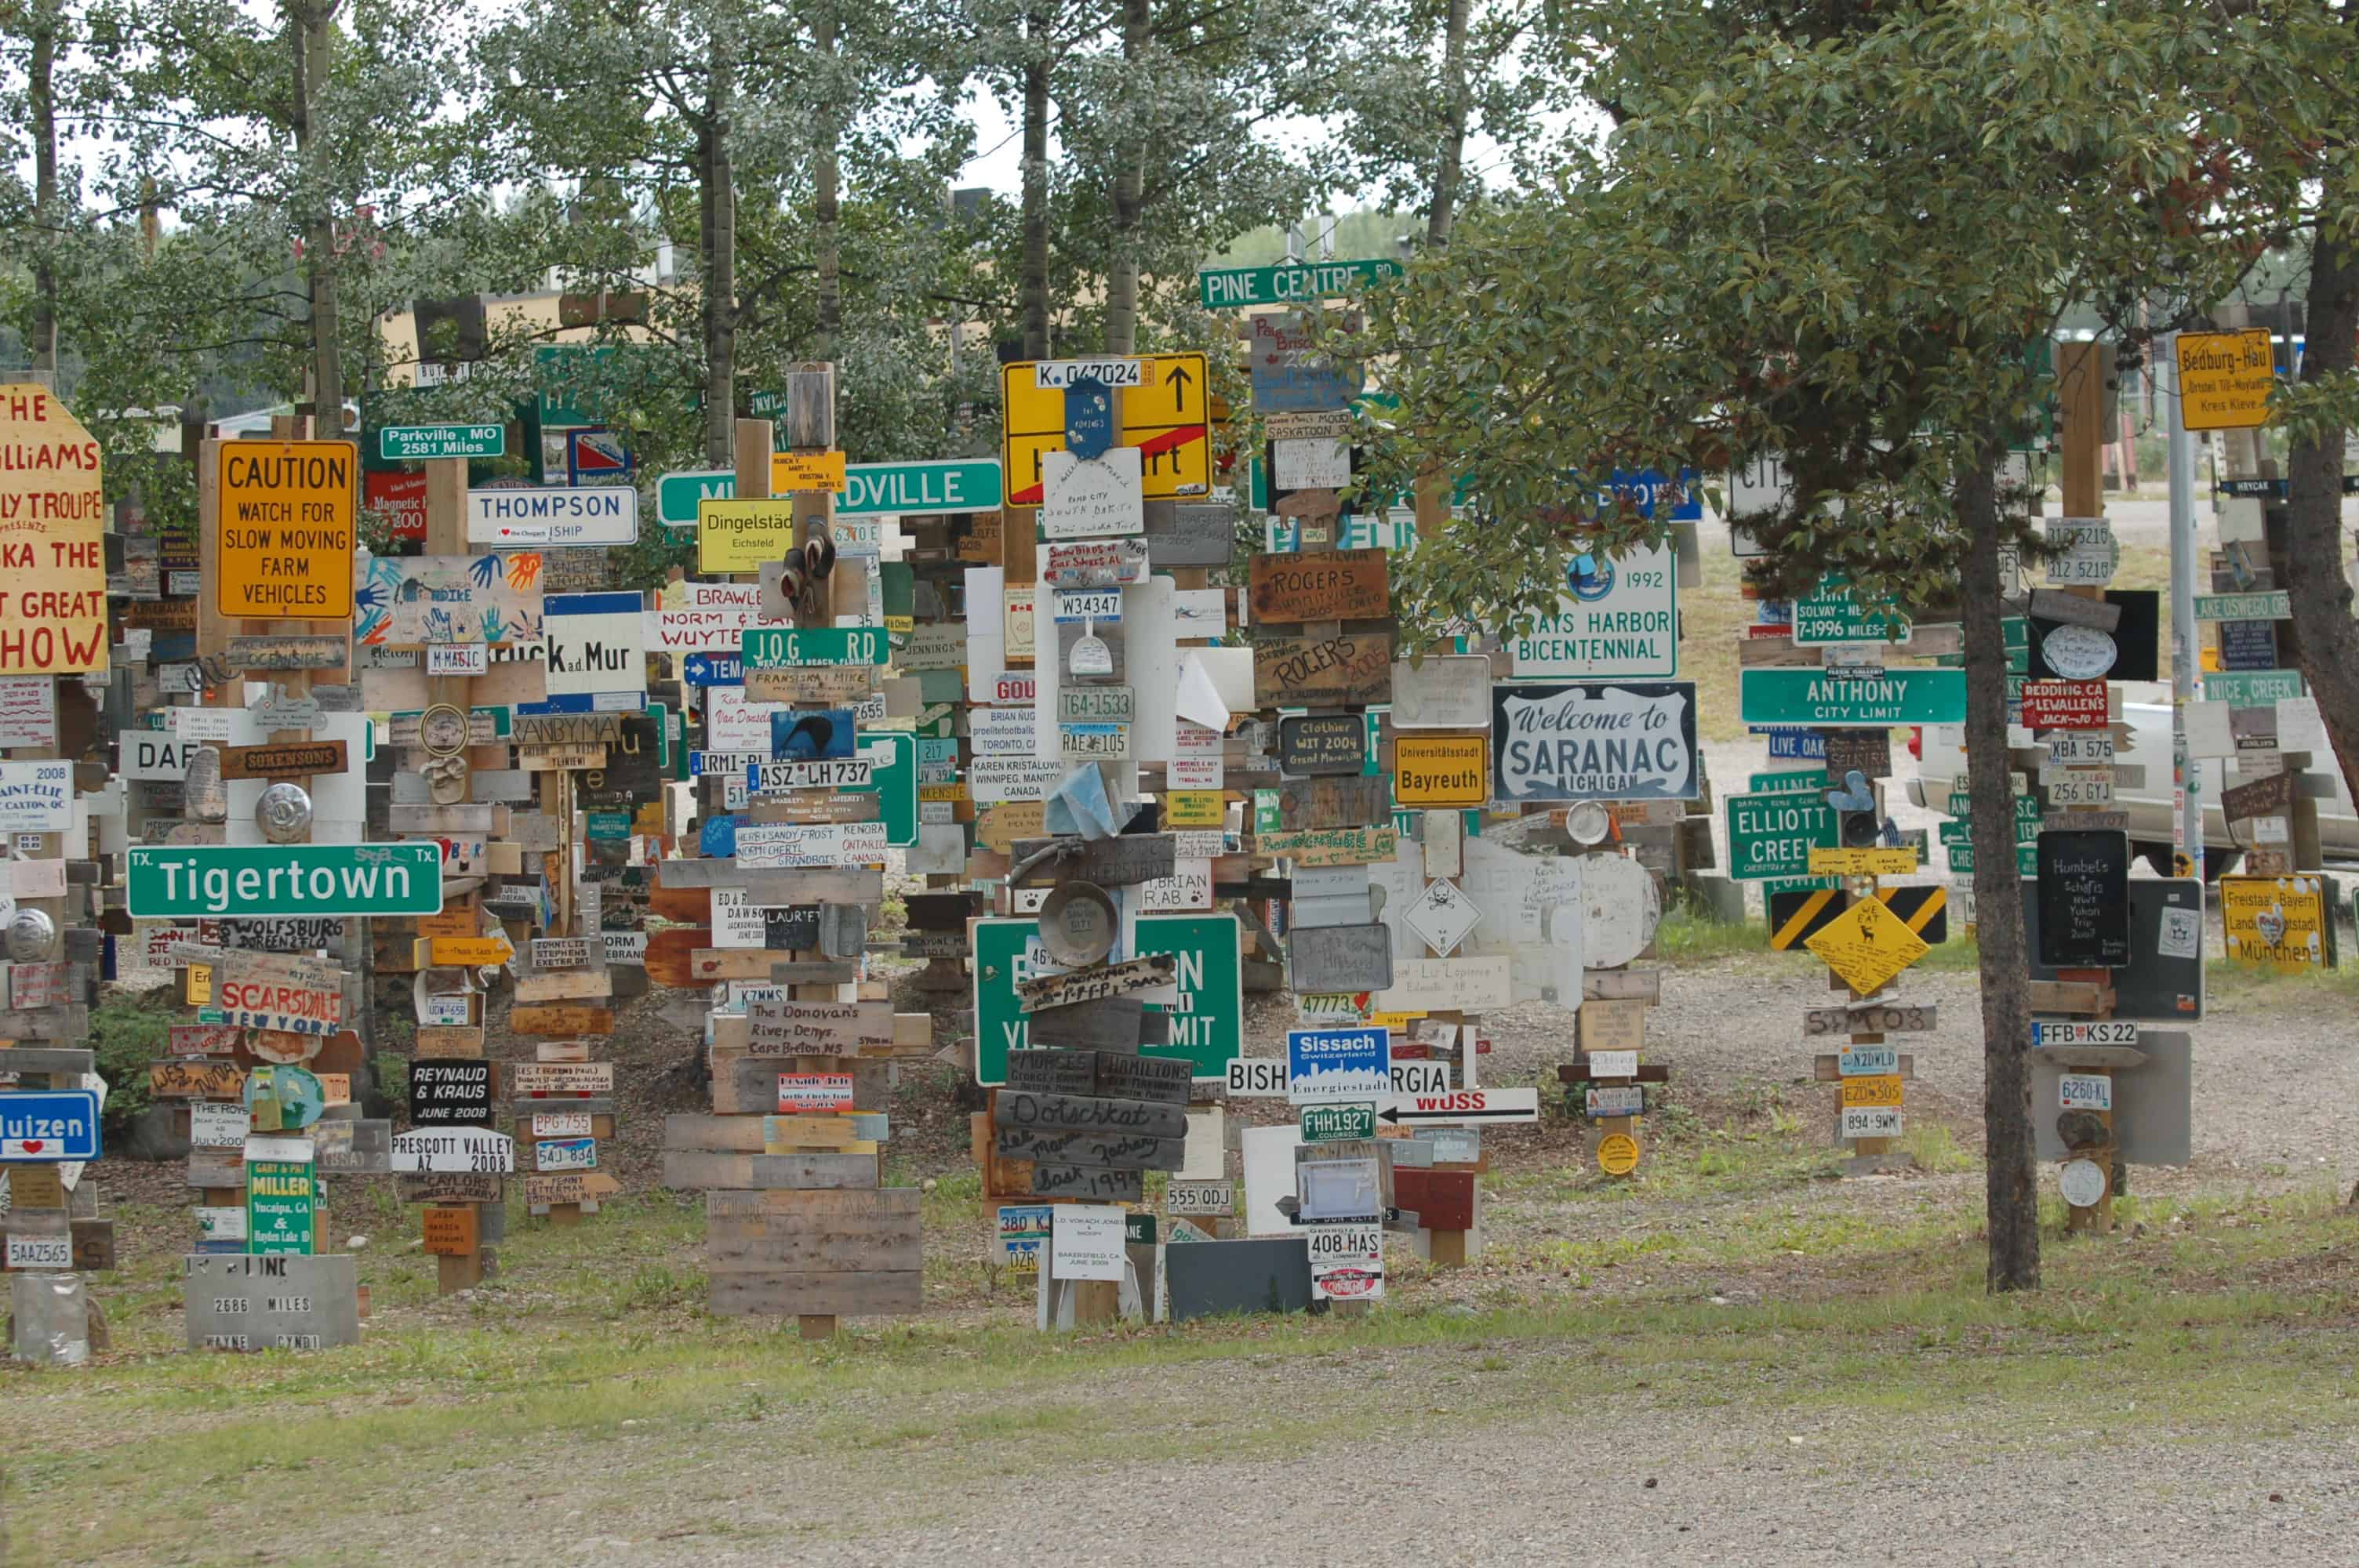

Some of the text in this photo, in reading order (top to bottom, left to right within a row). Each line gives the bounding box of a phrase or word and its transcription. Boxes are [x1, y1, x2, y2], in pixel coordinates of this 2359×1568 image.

[1207, 273, 1259, 302] PINE
[2183, 350, 2266, 375] Bedburg-Hau
[1041, 366, 1052, 385] K
[2201, 398, 2256, 412] Kreis Kleve
[470, 427, 496, 440] MO
[1267, 426, 1332, 438] SASKATOON
[402, 441, 484, 455] 2581 Miles
[228, 457, 346, 489] CAUTION
[27, 490, 101, 520] TROUPE
[374, 495, 420, 510] Magnetic
[480, 495, 620, 519] THOMPSON
[238, 503, 334, 522] WATCH FOR
[707, 514, 793, 533] Dingelstäd
[226, 530, 346, 550] SLOW MOVING
[732, 538, 775, 550] Eichsfeld
[51, 542, 99, 568] THE
[261, 557, 310, 577] FARM
[1270, 571, 1354, 593] ROGERS
[1627, 572, 1663, 589] 1992
[244, 584, 326, 604] VEHICLES
[21, 591, 103, 619] GREAT
[1063, 597, 1118, 612] W34347
[1799, 605, 1836, 618] SOLVAY
[2223, 597, 2268, 615] OSWEGO
[663, 613, 723, 626] NORM
[1588, 611, 1670, 633] HARBOR
[1798, 621, 1844, 637] 7-1996
[753, 633, 875, 660] JOG RD
[906, 643, 955, 655] JENNINGS
[1519, 639, 1661, 662] BICENTENNIAL
[586, 641, 645, 672] Mur
[1273, 636, 1355, 688] ROGERS
[834, 674, 865, 683] MIKE
[1806, 681, 1907, 702] ANTHONY
[2085, 684, 2103, 695] CA
[2211, 680, 2292, 699] NICE CREEK
[1063, 694, 1130, 716] T64-1533
[2036, 696, 2105, 710] LEWALLEN'S
[990, 712, 1016, 721] BRIAN
[1514, 700, 1670, 734] Welcome to
[1815, 707, 1902, 718] CITY LIMIT
[1300, 722, 1351, 733] Clothier
[983, 740, 1025, 750] TORONTO,
[1063, 733, 1125, 753] RAE 105
[1772, 738, 1826, 756] LIVE OAK
[2052, 741, 2112, 757] XBA 575
[245, 747, 335, 768] SORENSONS
[925, 746, 941, 759] 217
[1290, 754, 1318, 765] Grand
[1401, 746, 1479, 760] Universitätsstadt
[1510, 738, 1679, 775] SARANAC
[38, 768, 66, 779] 2008
[760, 762, 869, 786] ASZ LH 737
[974, 761, 1004, 771] KAREN
[976, 775, 1021, 784] WINNIPEG,
[1401, 770, 1478, 792] Bayreuth
[1557, 773, 1638, 791] MICHIGAN
[1004, 787, 1041, 797] CANADA
[2054, 784, 2110, 800] 256 GYJ
[1738, 808, 1826, 835] ELLIOTT
[768, 825, 885, 841] SANDY FROST KENORA
[842, 840, 886, 851] ONTARIO
[843, 854, 885, 862] CANADA
[159, 859, 411, 912] Tigertown
[718, 893, 729, 906] ED
[2279, 893, 2315, 910] Bayern
[1861, 906, 1877, 914] WE
[1857, 914, 1879, 923] EAT
[2074, 917, 2092, 927] Trip
[236, 918, 343, 936] WOLFSBURG
[738, 931, 751, 939] JUNE
[222, 982, 342, 1022] SCARSDALE
[1303, 995, 1350, 1011] 47773
[753, 1004, 860, 1018] The Donovan's
[223, 1011, 339, 1036] NEW YORK
[751, 1024, 791, 1037] River
[2041, 1024, 2135, 1043] FFB KS 22
[749, 1043, 842, 1054] Cape NS
[1299, 1035, 1376, 1052] Sissach
[1300, 1051, 1376, 1060] Switzerland
[414, 1067, 486, 1082] REYNAUD
[416, 1085, 485, 1098] & KRAUS
[1292, 1081, 1390, 1094] Energiestadt
[1877, 1085, 1899, 1099] 505
[194, 1104, 217, 1114] THE
[418, 1107, 487, 1118] JUNE 2008
[1305, 1112, 1372, 1133] FHH1927
[192, 1138, 218, 1146] JULY
[392, 1137, 511, 1155] PRESCOTT VALLEY
[417, 1156, 507, 1171] AZ 2008
[539, 1148, 593, 1163] 54J 834
[253, 1178, 310, 1196] MILLER
[1169, 1191, 1196, 1204] 555
[295, 1202, 308, 1213] CA
[820, 1196, 913, 1221] FAMILY
[274, 1218, 288, 1229] &
[1311, 1233, 1379, 1253] 408 HAS
[11, 1243, 68, 1263] 5AAZ565
[268, 1298, 311, 1311] MILES
